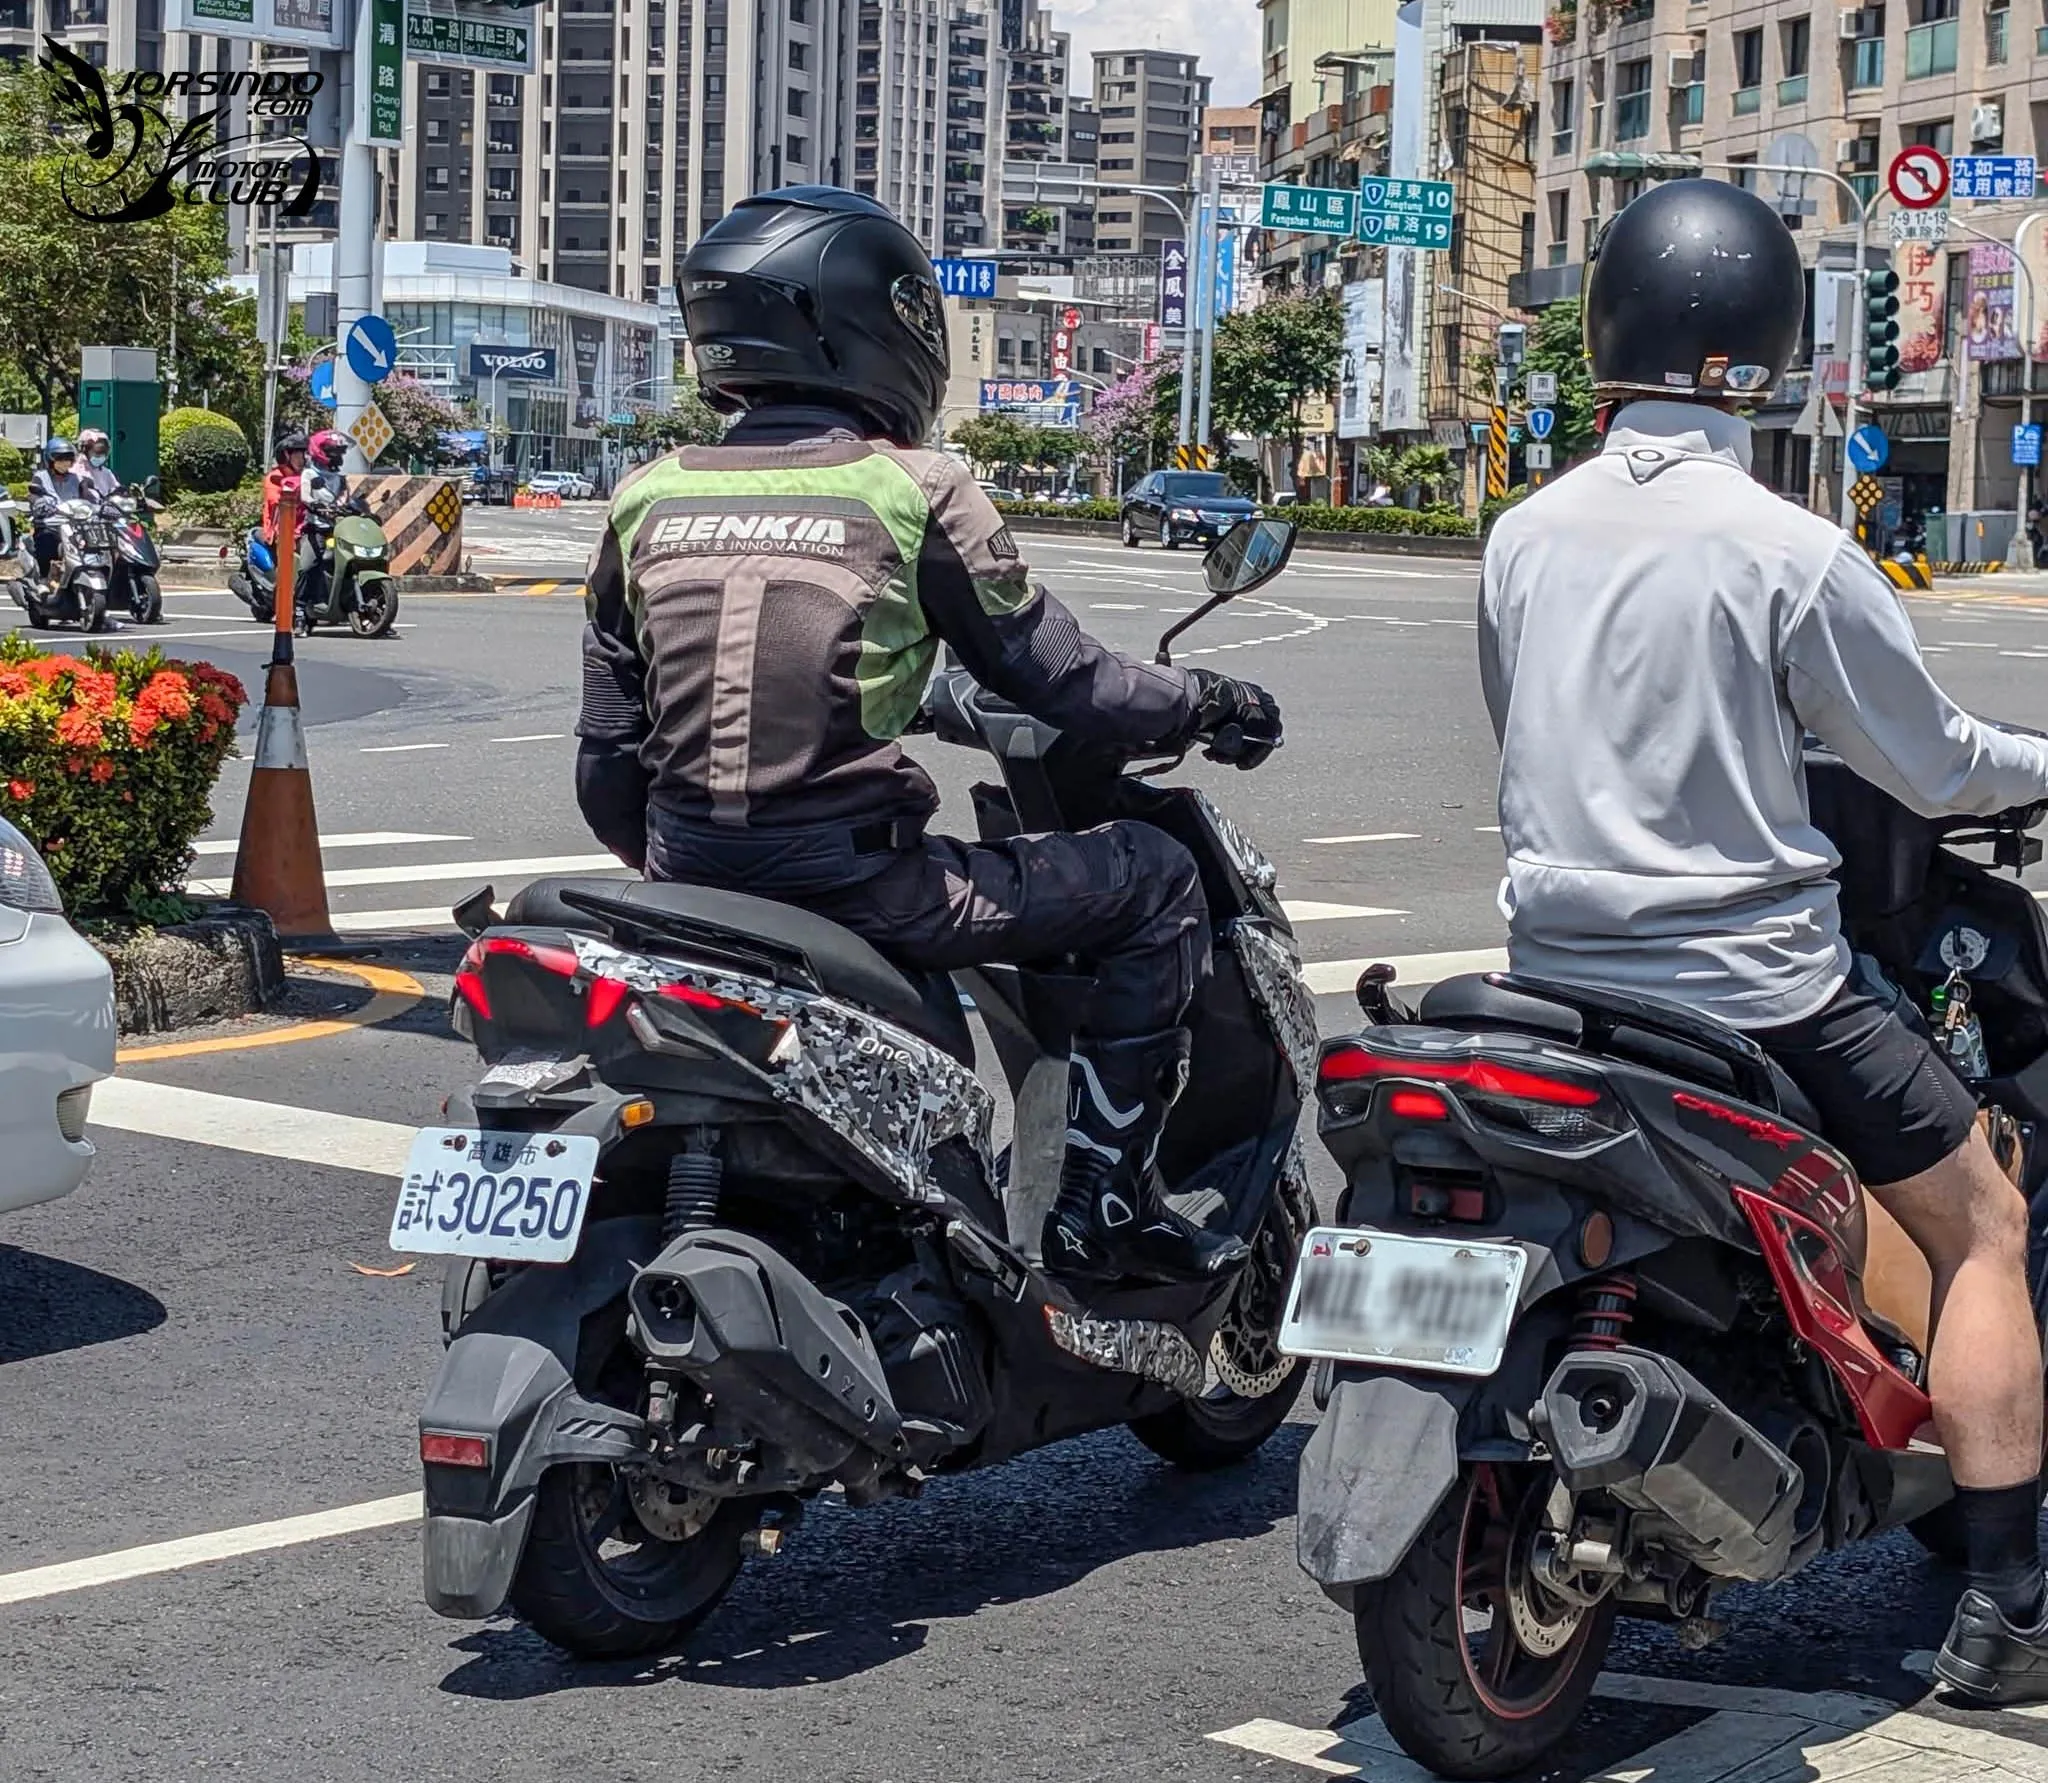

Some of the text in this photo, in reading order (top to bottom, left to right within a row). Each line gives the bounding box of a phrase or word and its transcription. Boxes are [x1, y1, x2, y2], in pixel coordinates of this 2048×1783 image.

[408, 16, 459, 39] 九如一路
[372, 93, 400, 106] Cheng
[376, 108, 396, 122] Cing
[378, 121, 392, 133] Rd
[1955, 159, 2032, 178] 九如一路
[1386, 182, 1422, 200] 屏東
[1954, 178, 2031, 196] 專用號誌
[1272, 190, 1345, 216] 鳳山區
[1384, 199, 1423, 213] Pingtung
[1427, 190, 1450, 209] 10
[1270, 213, 1344, 229] Fengshan District
[1890, 212, 1947, 225] 7-9 17-19
[1384, 233, 1417, 245] Linluo
[1425, 224, 1447, 241] 19
[480, 353, 547, 370] VOLVO
[1538, 413, 1545, 431] 1
[2014, 425, 2025, 440] P
[649, 515, 846, 545] BENKIA
[651, 540, 845, 556] SAFETY & INNOVATION
[467, 1140, 540, 1165] 高雄市
